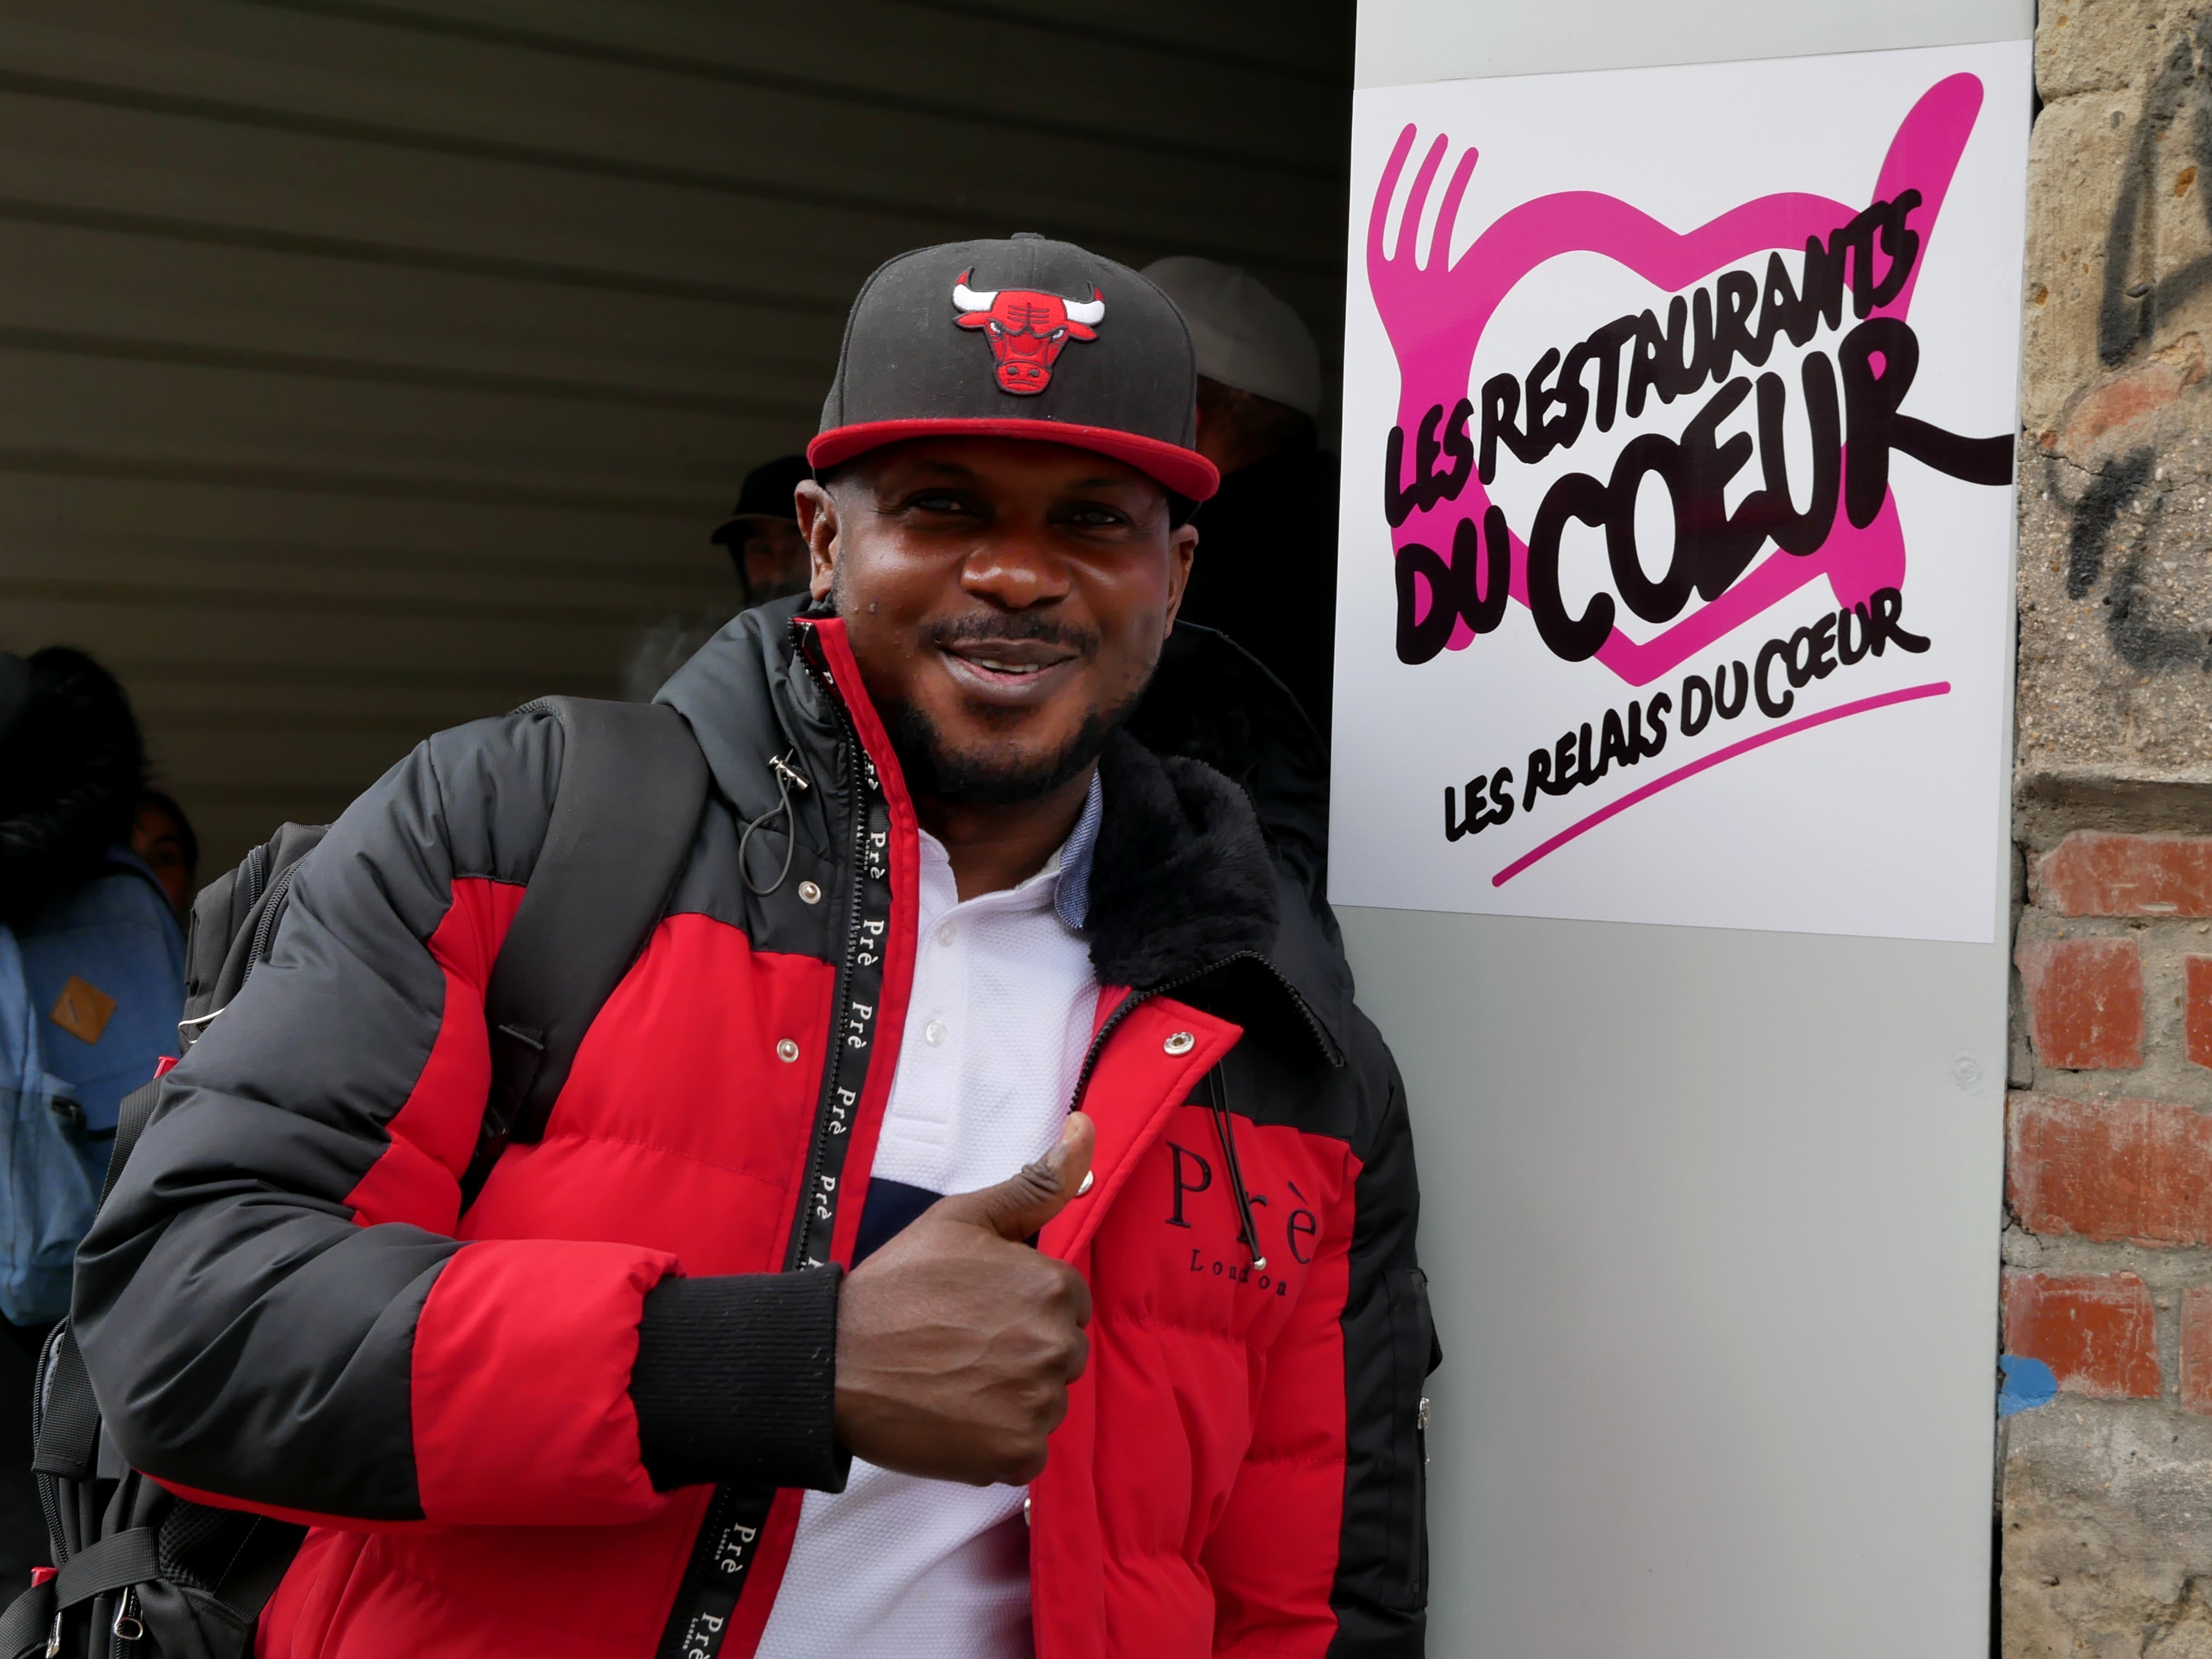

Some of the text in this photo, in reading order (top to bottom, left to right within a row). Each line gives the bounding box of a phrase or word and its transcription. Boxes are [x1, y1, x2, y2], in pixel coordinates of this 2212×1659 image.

[1385, 398, 1474, 528] LES
[1478, 188, 1922, 486] RESTAURANTS
[1395, 505, 1511, 666] DU
[1445, 767, 1515, 843] LES
[1522, 692, 1673, 813] RELAIS
[1680, 660, 1749, 737] DU
[869, 831, 886, 879] Prè
[857, 919, 884, 966] Prè
[848, 1001, 873, 1049] Prè
[828, 1085, 857, 1135] Prè
[816, 1175, 836, 1220] Prè
[1190, 1248, 1287, 1296] London
[721, 1522, 757, 1574] Prè
